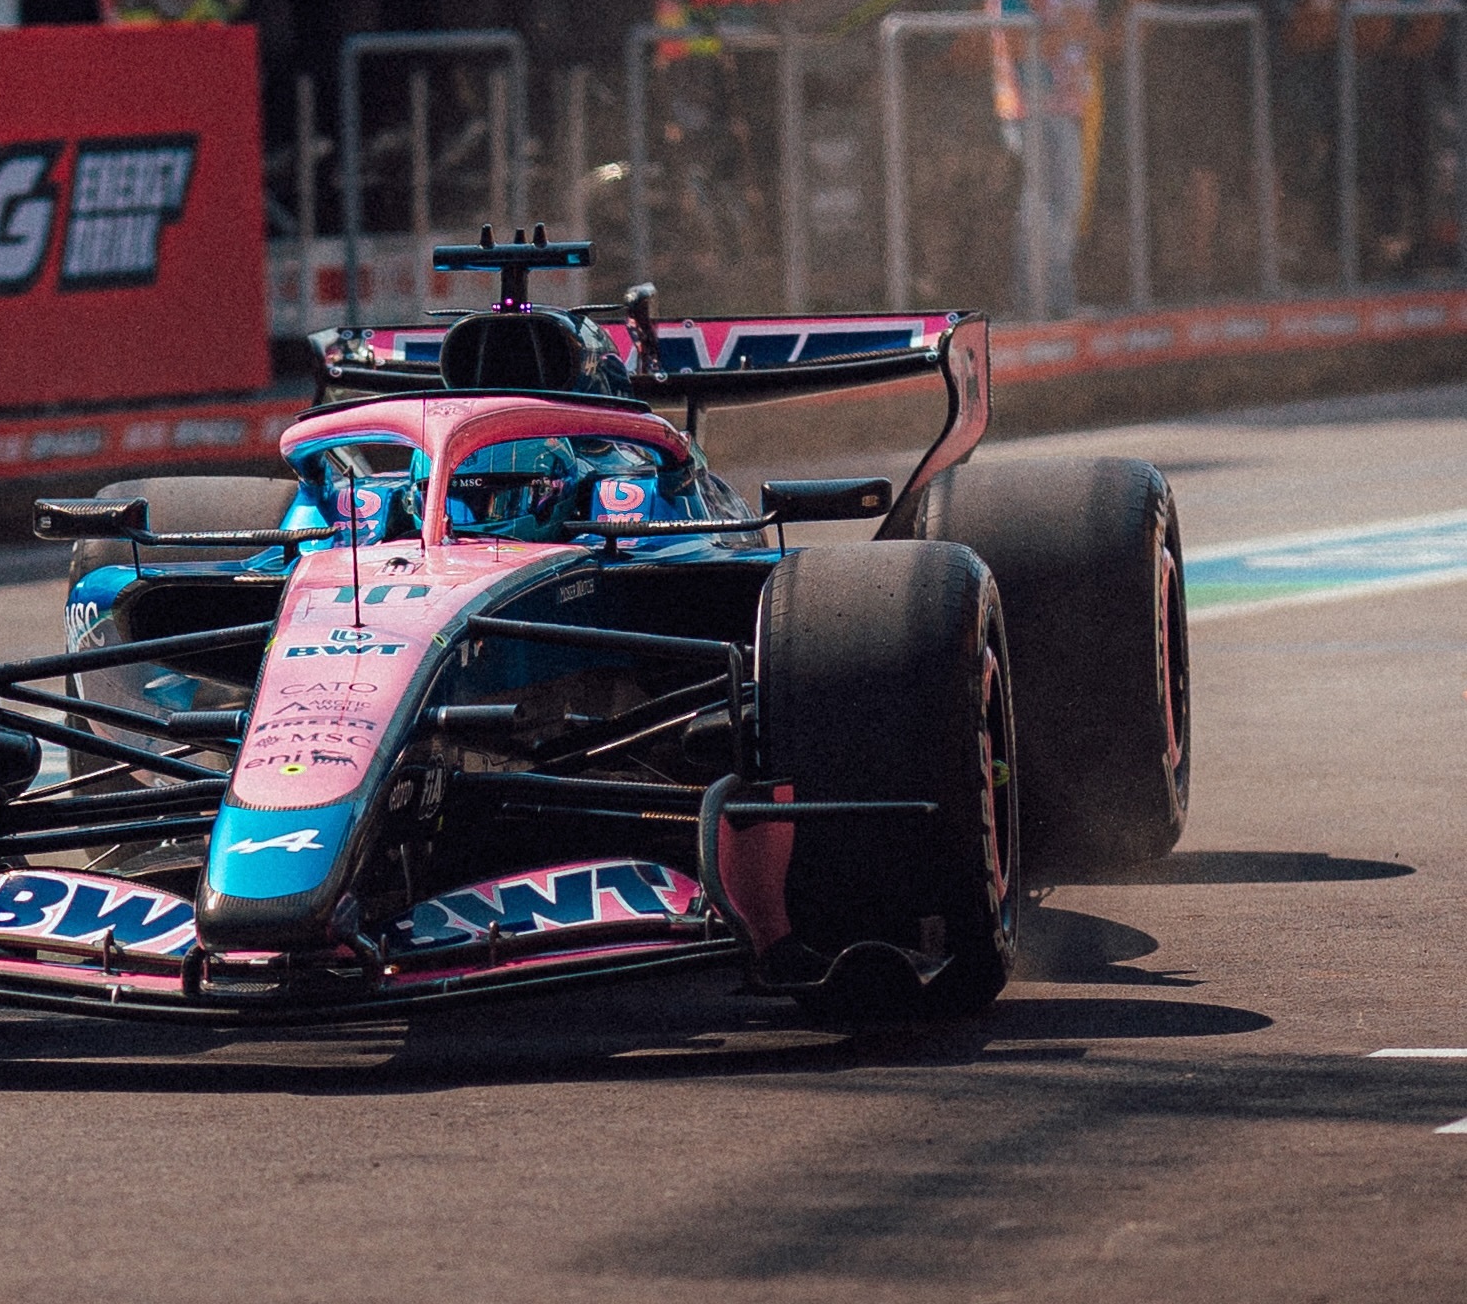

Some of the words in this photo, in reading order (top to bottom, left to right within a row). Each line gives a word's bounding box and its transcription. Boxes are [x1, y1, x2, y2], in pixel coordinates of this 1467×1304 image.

[459, 478, 483, 487] MSC
[283, 643, 409, 660] BWT
[279, 682, 378, 695] CATO
[308, 699, 372, 709] ARCTIC
[315, 705, 365, 713] WOLF
[290, 732, 375, 750] MSC
[244, 750, 304, 769] eni
[388, 860, 681, 946] BWT
